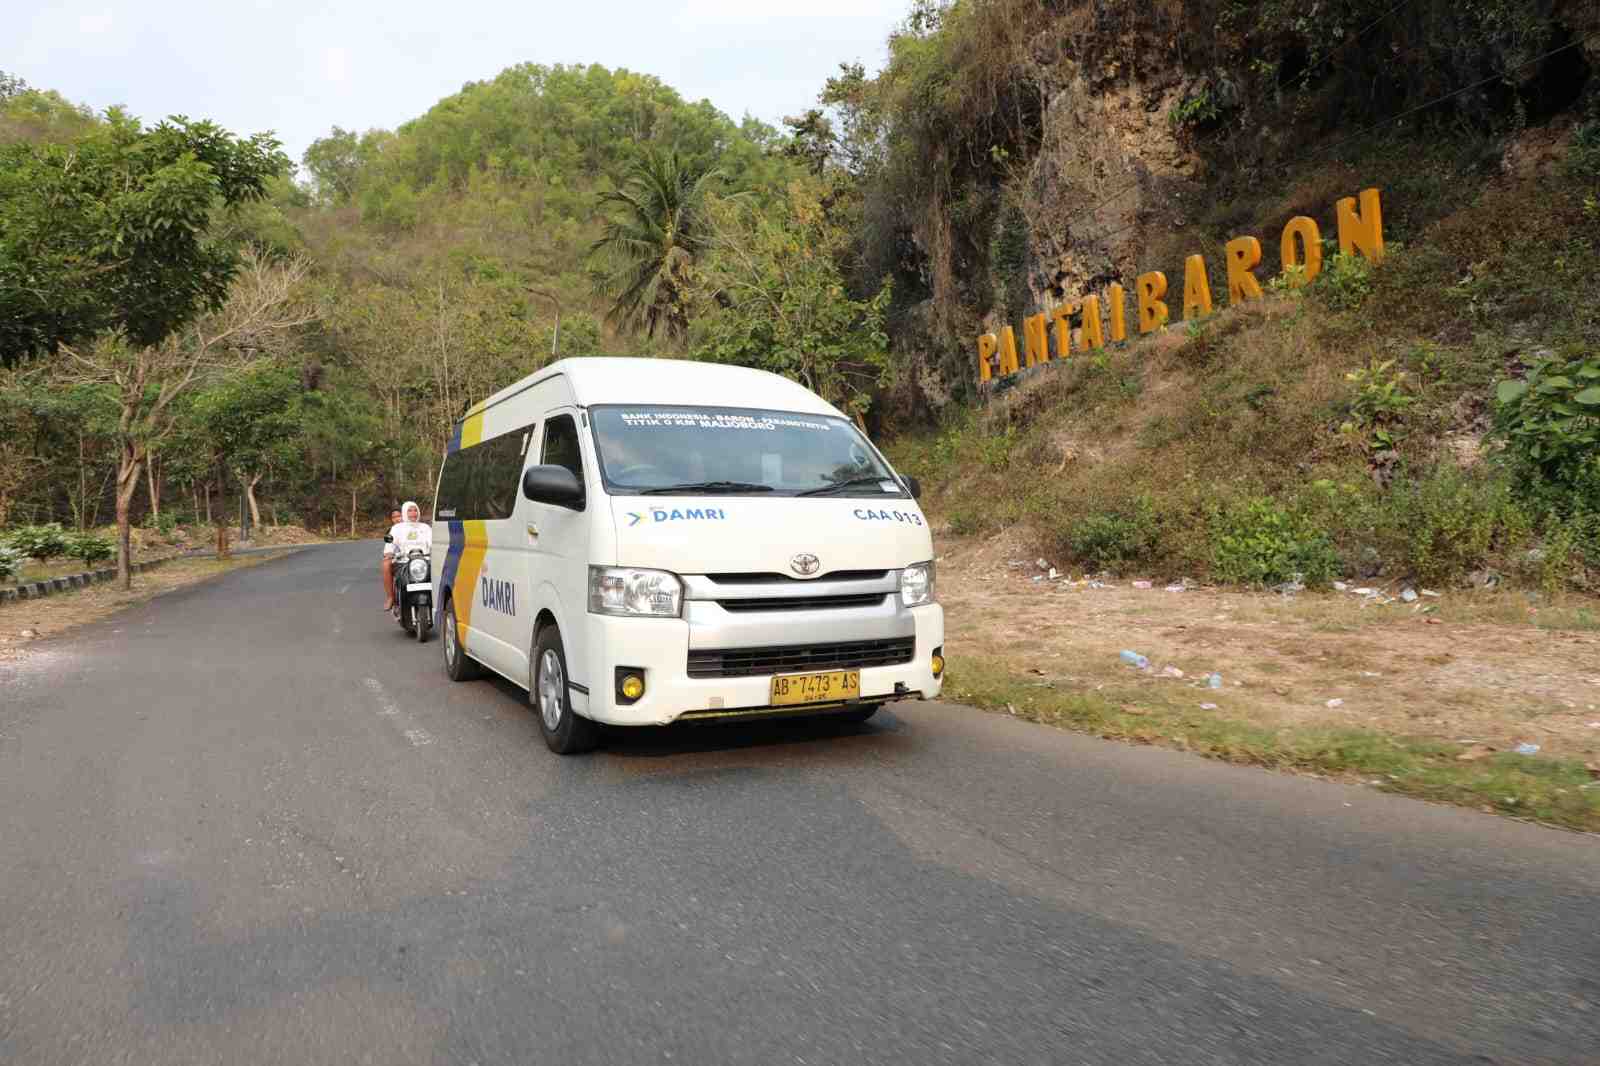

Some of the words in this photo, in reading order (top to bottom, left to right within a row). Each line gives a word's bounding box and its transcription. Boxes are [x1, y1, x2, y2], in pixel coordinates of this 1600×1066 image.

[978, 284, 1127, 383] PANTAI
[1136, 187, 1385, 335] BARON
[675, 419, 697, 427] KM
[653, 508, 725, 522] DAMRI
[853, 509, 893, 521] CAA
[893, 510, 922, 526] 013
[482, 576, 516, 617] DAMRI
[774, 678, 789, 697] AB
[800, 674, 830, 694] 7473
[842, 672, 857, 689] AS
